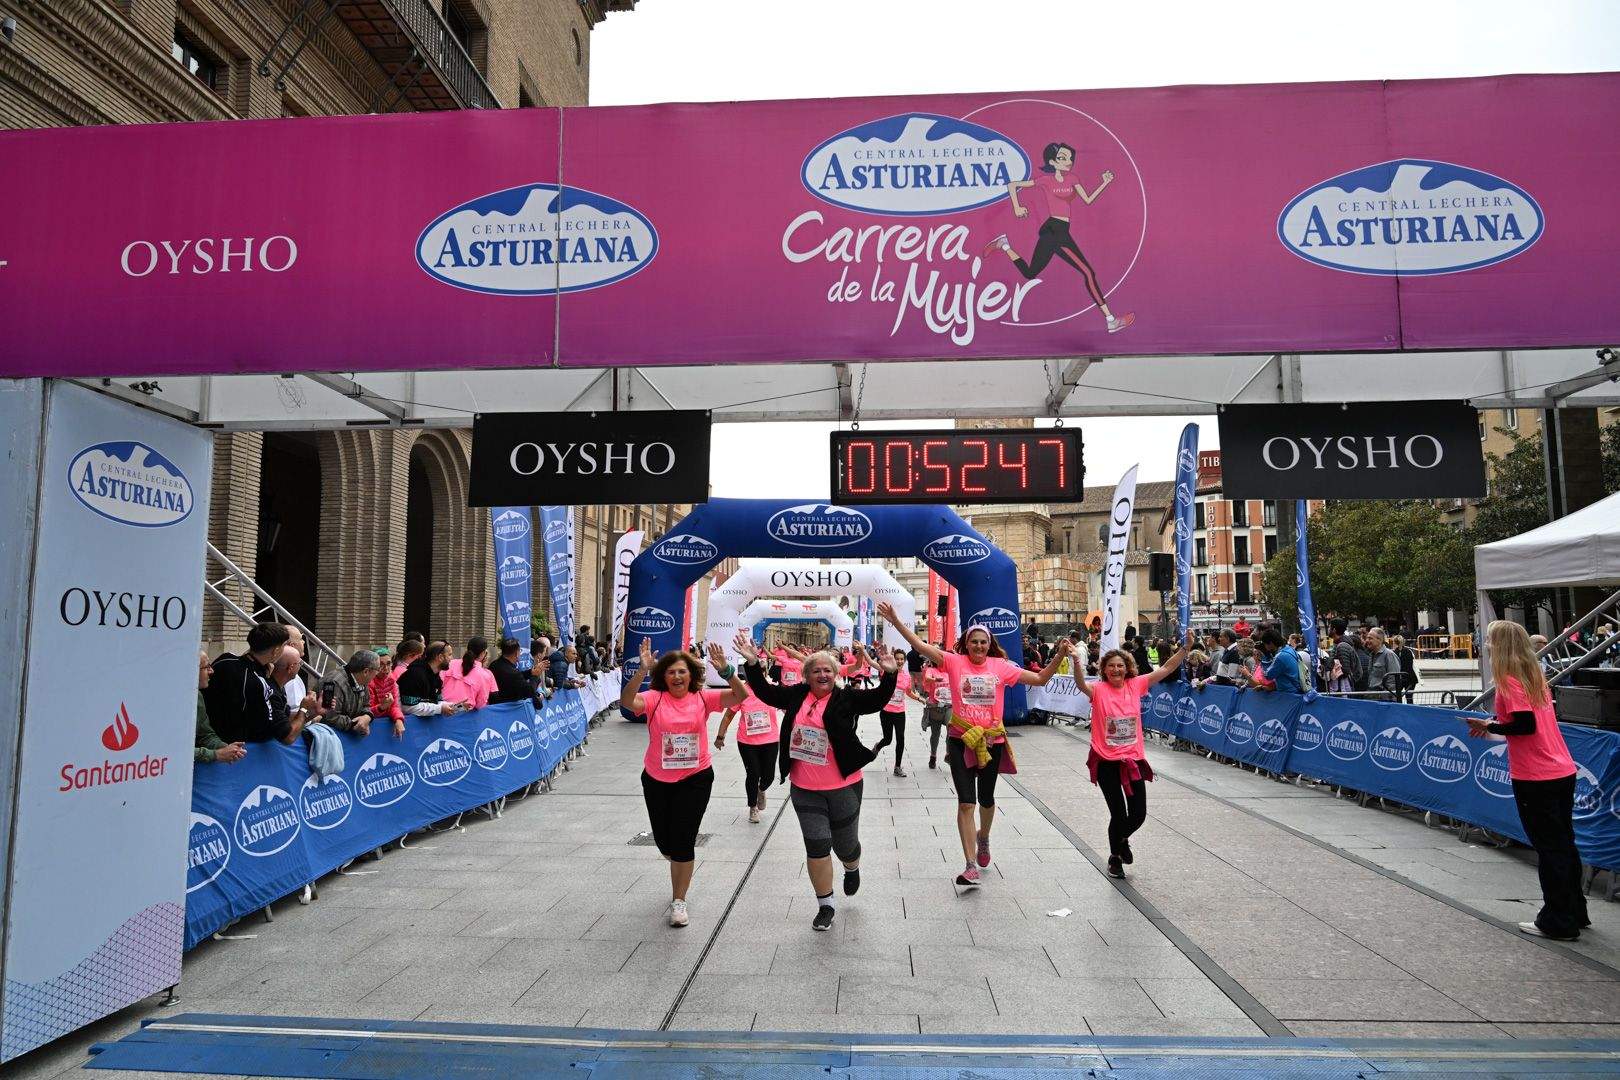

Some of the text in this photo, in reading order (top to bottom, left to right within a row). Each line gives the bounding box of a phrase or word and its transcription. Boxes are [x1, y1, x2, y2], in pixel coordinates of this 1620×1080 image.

[854, 147, 1006, 160] CENTRAL LECHERA
[818, 152, 1011, 191] ASTURIANA
[1338, 196, 1514, 213] CENTRAL LECHERA
[471, 220, 632, 235] CENTRAL LECHERA
[782, 211, 969, 263] Carrera
[1299, 205, 1525, 247] ASTURIANA
[120, 235, 298, 277] OYSHO
[433, 228, 639, 269] ASTURIANA
[827, 256, 1043, 346] de la Mujer
[510, 442, 676, 476] OYSHO
[1202, 456, 1220, 468] TIB
[1262, 434, 1444, 471] OYSHO
[78, 461, 186, 513] ASTURIANA
[101, 463, 184, 490] CENTRAL LECHERA
[775, 517, 865, 536] ASTURIANA
[657, 544, 713, 558] ASTURIANA
[930, 547, 987, 558] ASTURIANA
[771, 570, 853, 588] OYSHO
[60, 587, 187, 630] OYSHO
[1295, 730, 1320, 744] TURIANA
[1328, 732, 1363, 753] ASTURIANA
[1372, 740, 1410, 763] ASTURIANA
[1420, 749, 1467, 774] ASTURIANA
[59, 754, 168, 792] Santander
[423, 755, 469, 779] ASTURIANA
[1477, 758, 1512, 786] ASTURIA
[360, 771, 411, 800] ASTURIANA
[304, 792, 350, 820] ASTURIANA
[241, 809, 299, 847] ASTURIANA
[188, 838, 228, 869] RIANA
